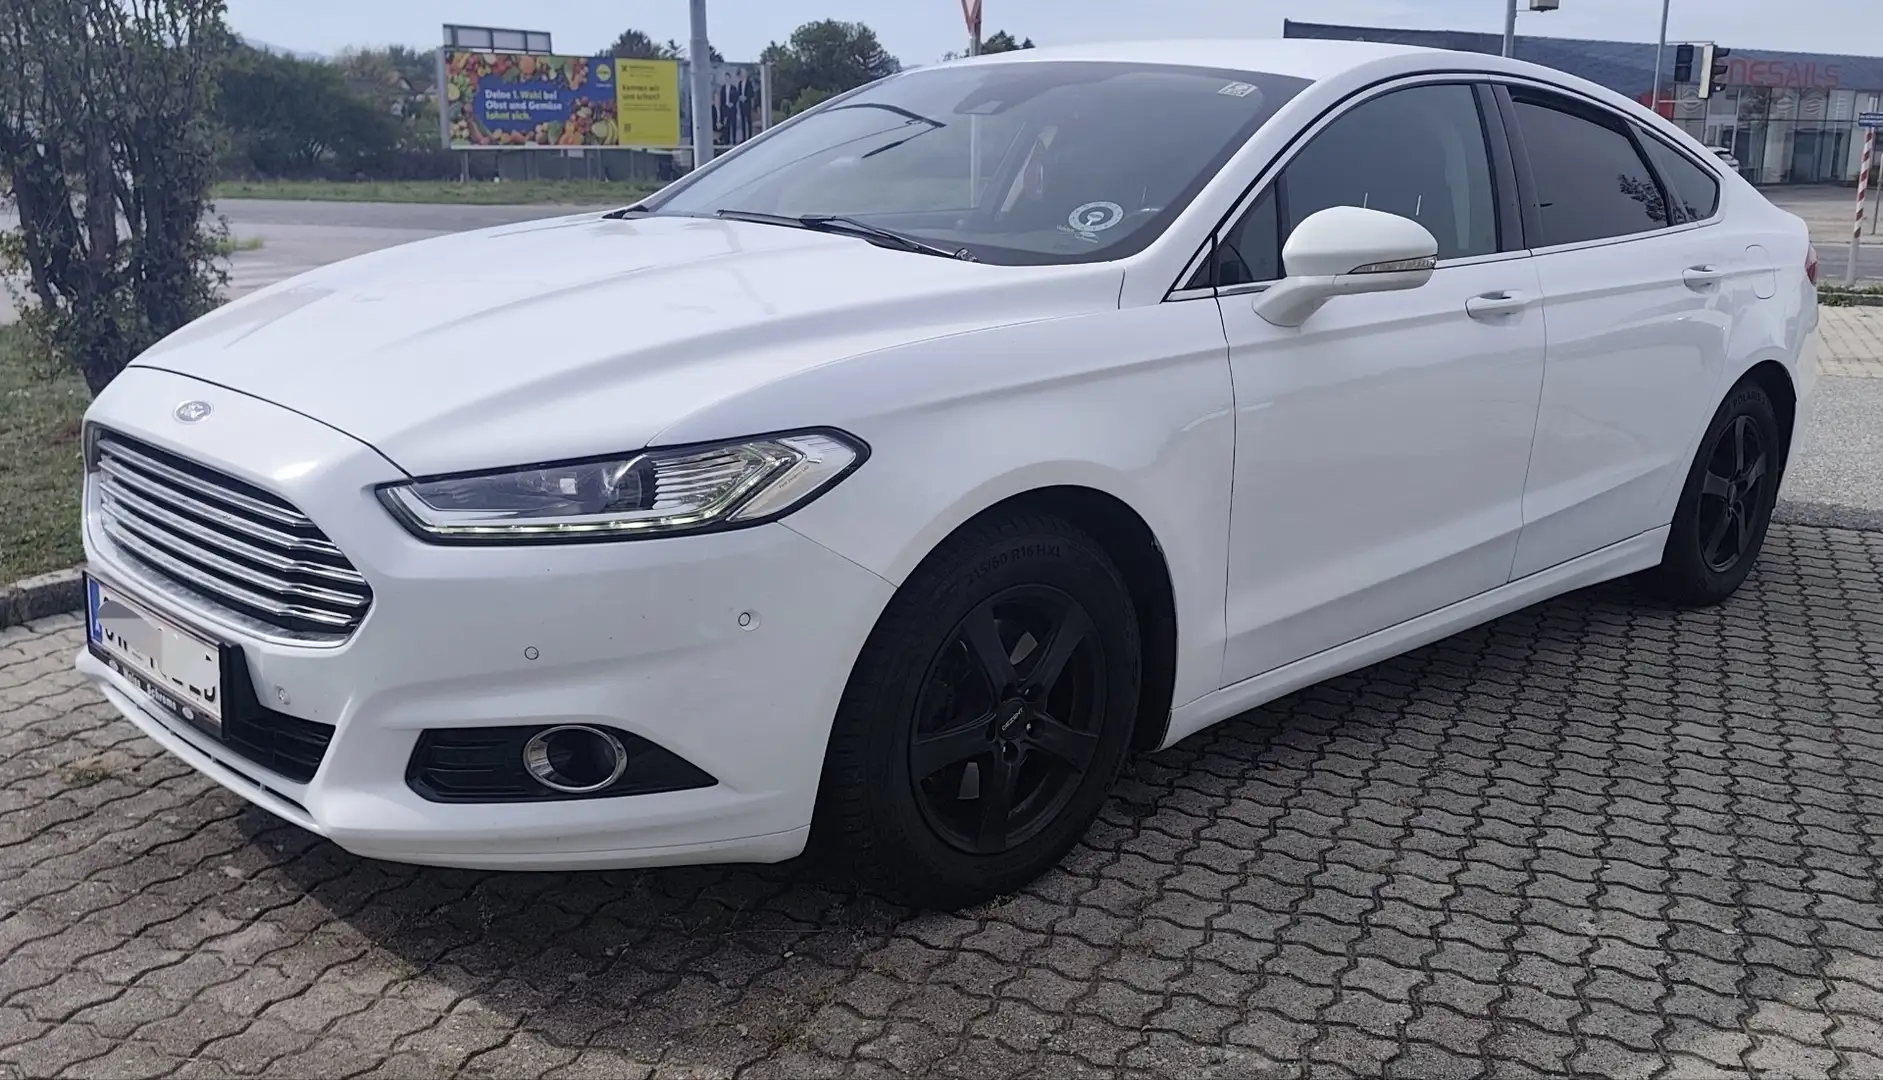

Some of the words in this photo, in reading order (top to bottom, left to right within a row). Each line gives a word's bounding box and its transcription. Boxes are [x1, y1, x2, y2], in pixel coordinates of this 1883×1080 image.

[1716, 57, 1842, 88] NESAILS
[485, 89, 511, 100] Deine
[519, 90, 542, 100] Wahl
[543, 90, 558, 100] bei
[485, 100, 508, 110] Obst
[509, 101, 527, 110] und
[528, 100, 563, 111] Gemüse
[486, 111, 510, 120] lohnt
[1012, 547, 1034, 560] R16
